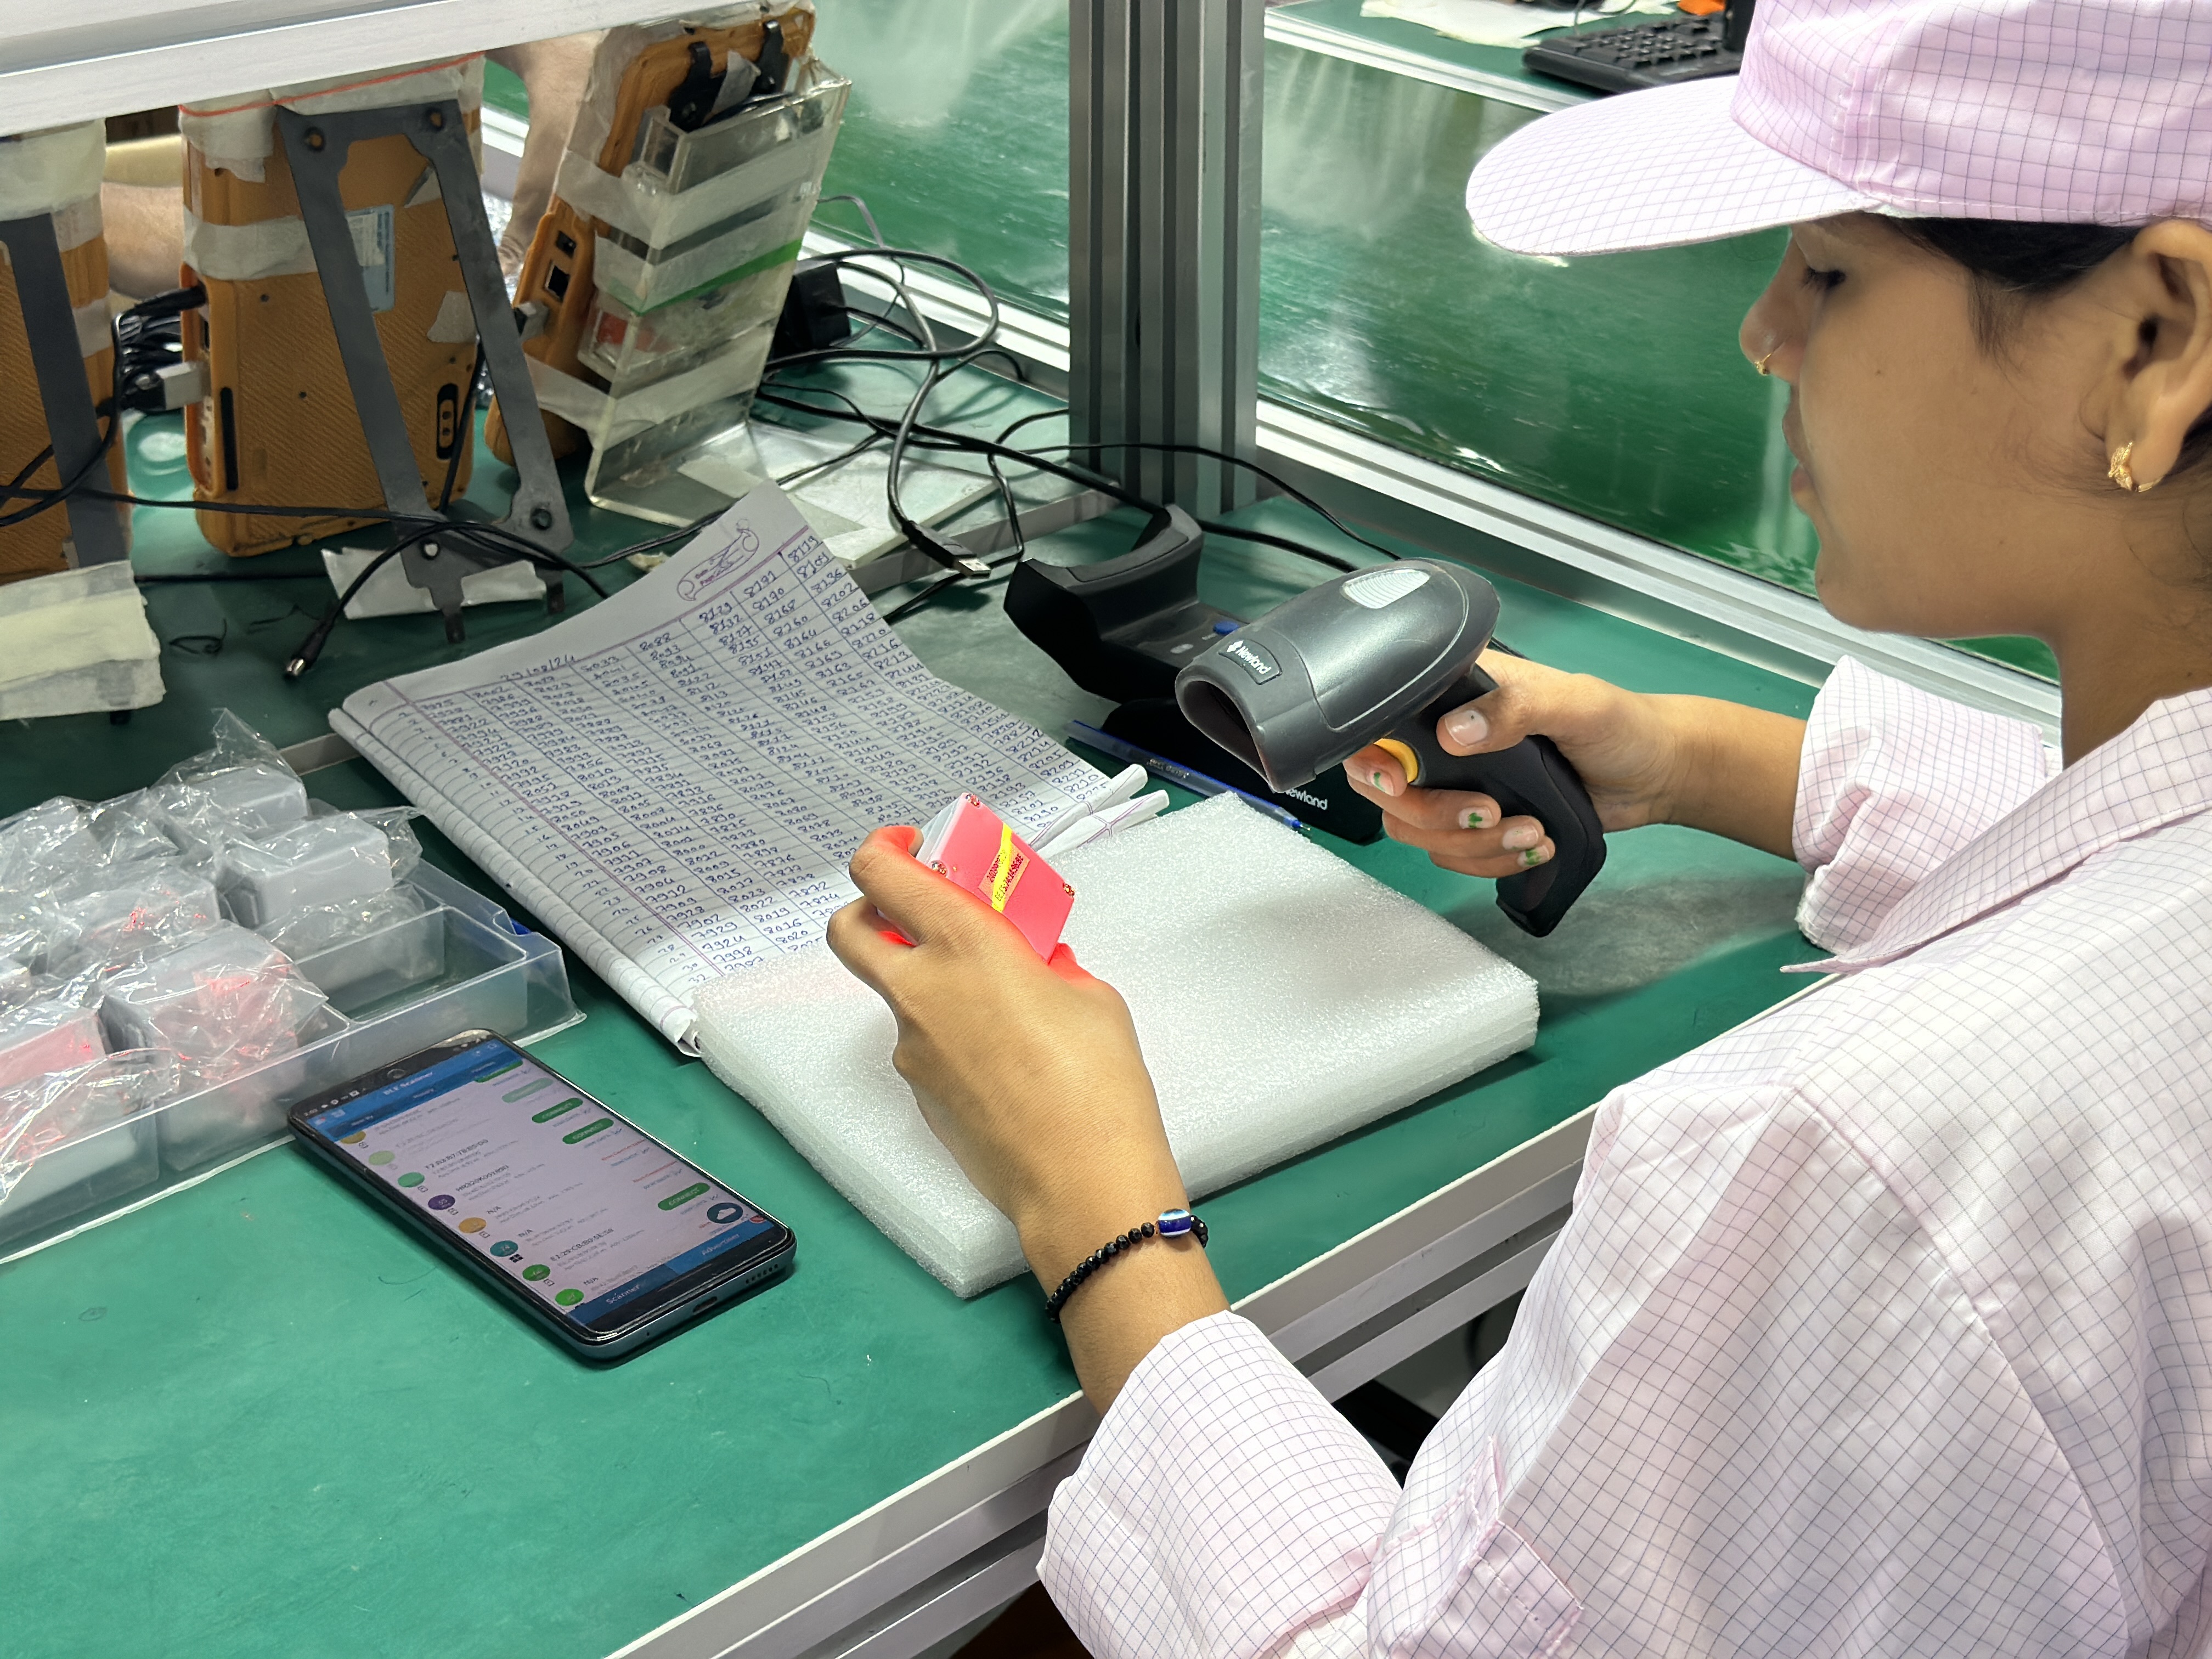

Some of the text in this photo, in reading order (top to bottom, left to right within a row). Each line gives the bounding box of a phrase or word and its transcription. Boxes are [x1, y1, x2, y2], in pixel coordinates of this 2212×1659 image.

[822, 582, 857, 607] 8202
[774, 616, 808, 637] 8160
[785, 629, 817, 649] 8164
[862, 638, 899, 659] 8216
[874, 651, 909, 670] 8213
[1235, 646, 1272, 674] Newland
[1064, 775, 1098, 793] 8210
[1284, 787, 1328, 810] ewland
[728, 888, 765, 902] 8023
[763, 918, 802, 934] 8016
[776, 930, 808, 944] 8020
[669, 1187, 700, 1206] CONNECT
[487, 1205, 501, 1215] N/A
[518, 1229, 533, 1238] N/A
[606, 1285, 640, 1305] Scanner
